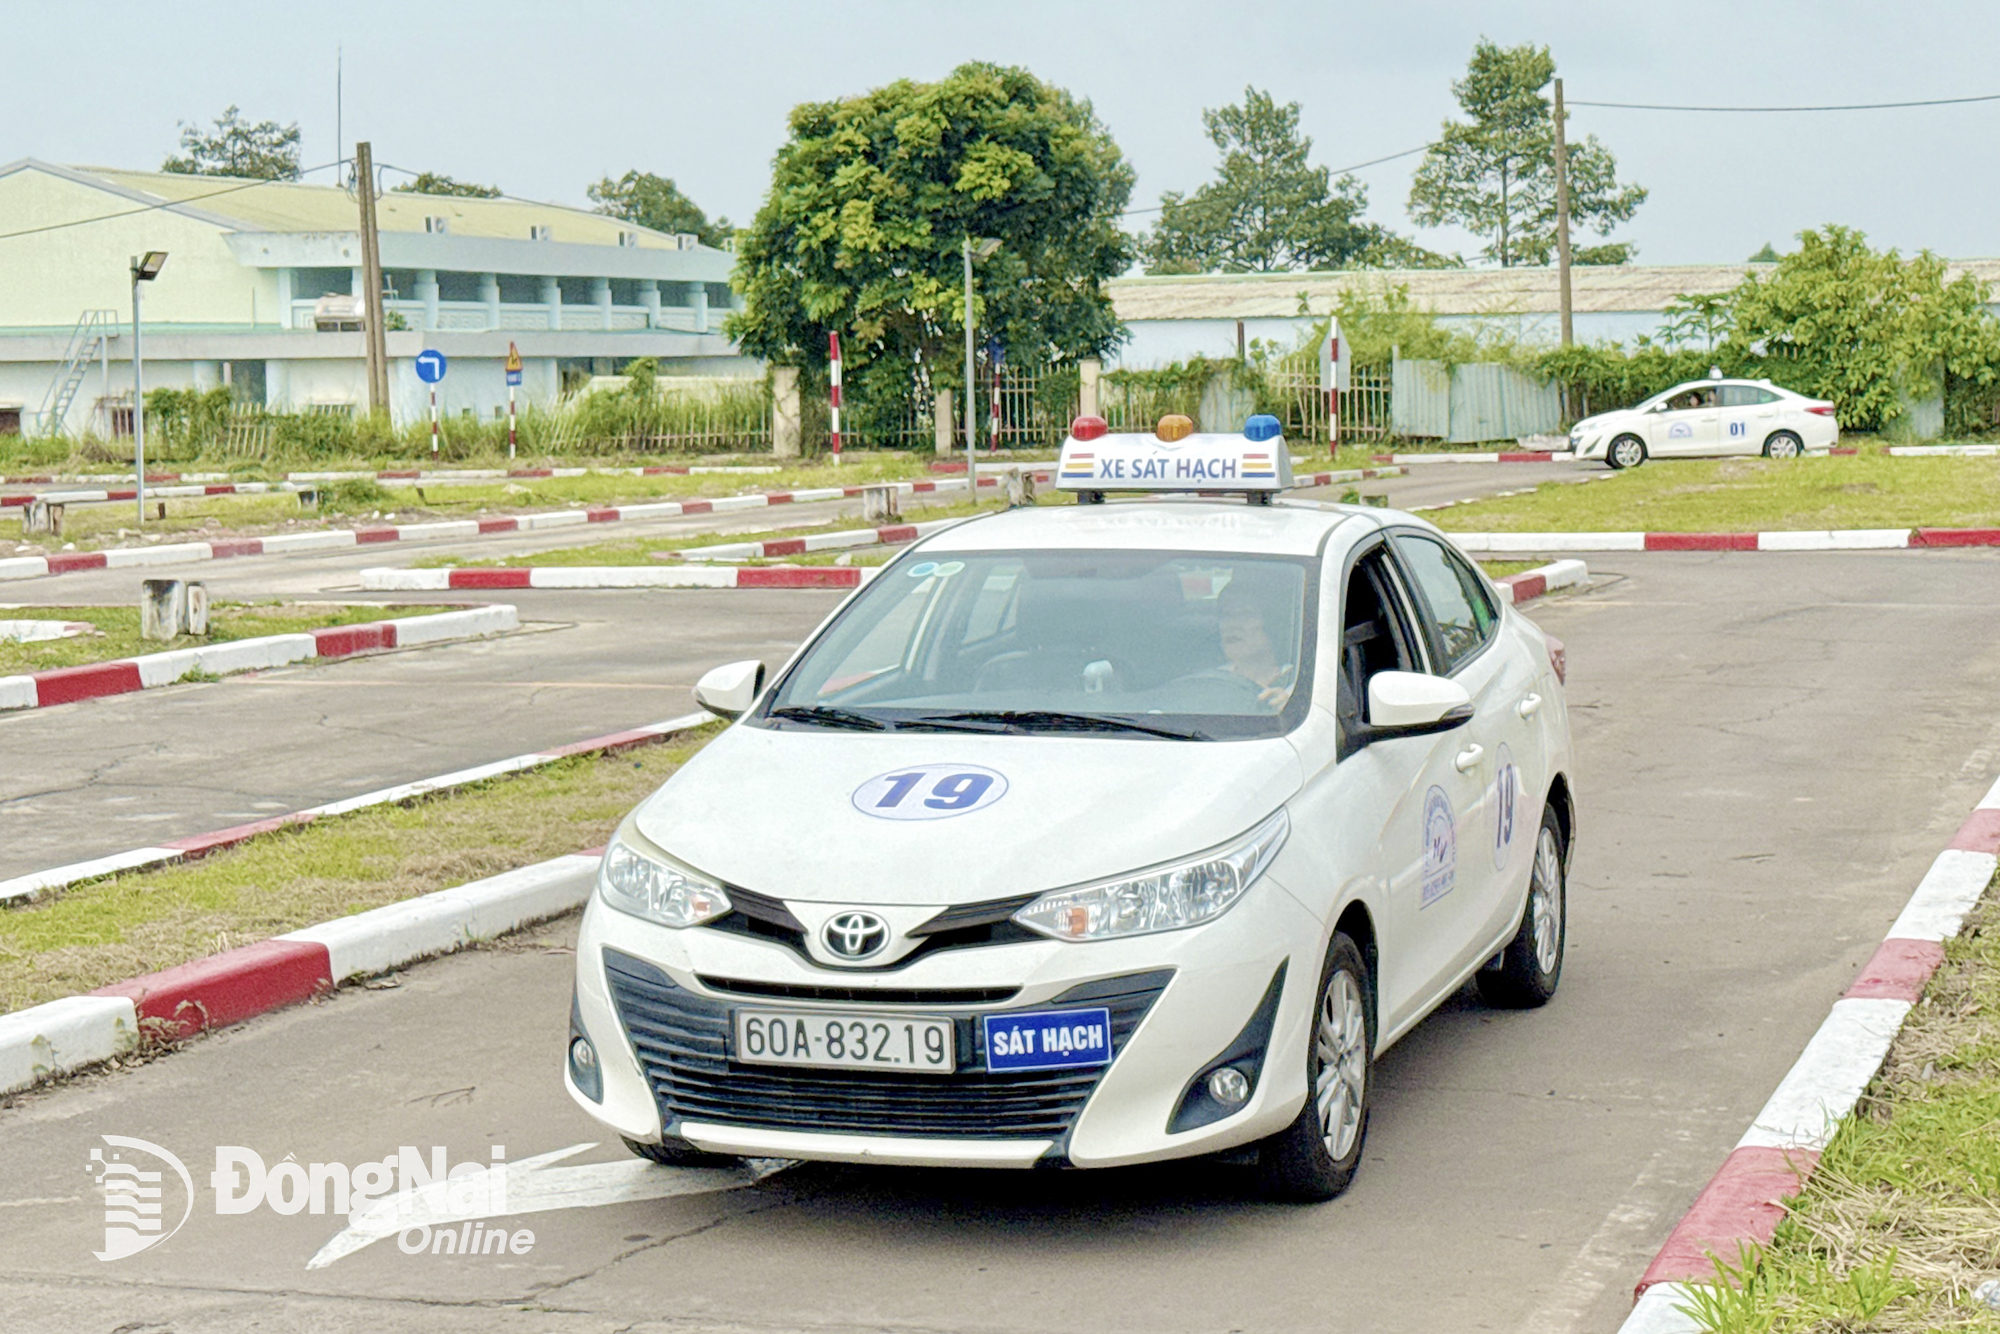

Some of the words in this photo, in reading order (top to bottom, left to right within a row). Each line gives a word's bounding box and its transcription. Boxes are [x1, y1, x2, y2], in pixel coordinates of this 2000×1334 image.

[1730, 422, 1745, 436] 01
[1100, 458, 1126, 478] XE
[1176, 458, 1237, 483] HẠCH
[875, 772, 994, 810] 19
[1496, 763, 1514, 849] 19
[746, 1017, 945, 1065] 60A-832.19
[993, 1025, 1036, 1056] SÁT
[1042, 1024, 1104, 1057] HẠCH
